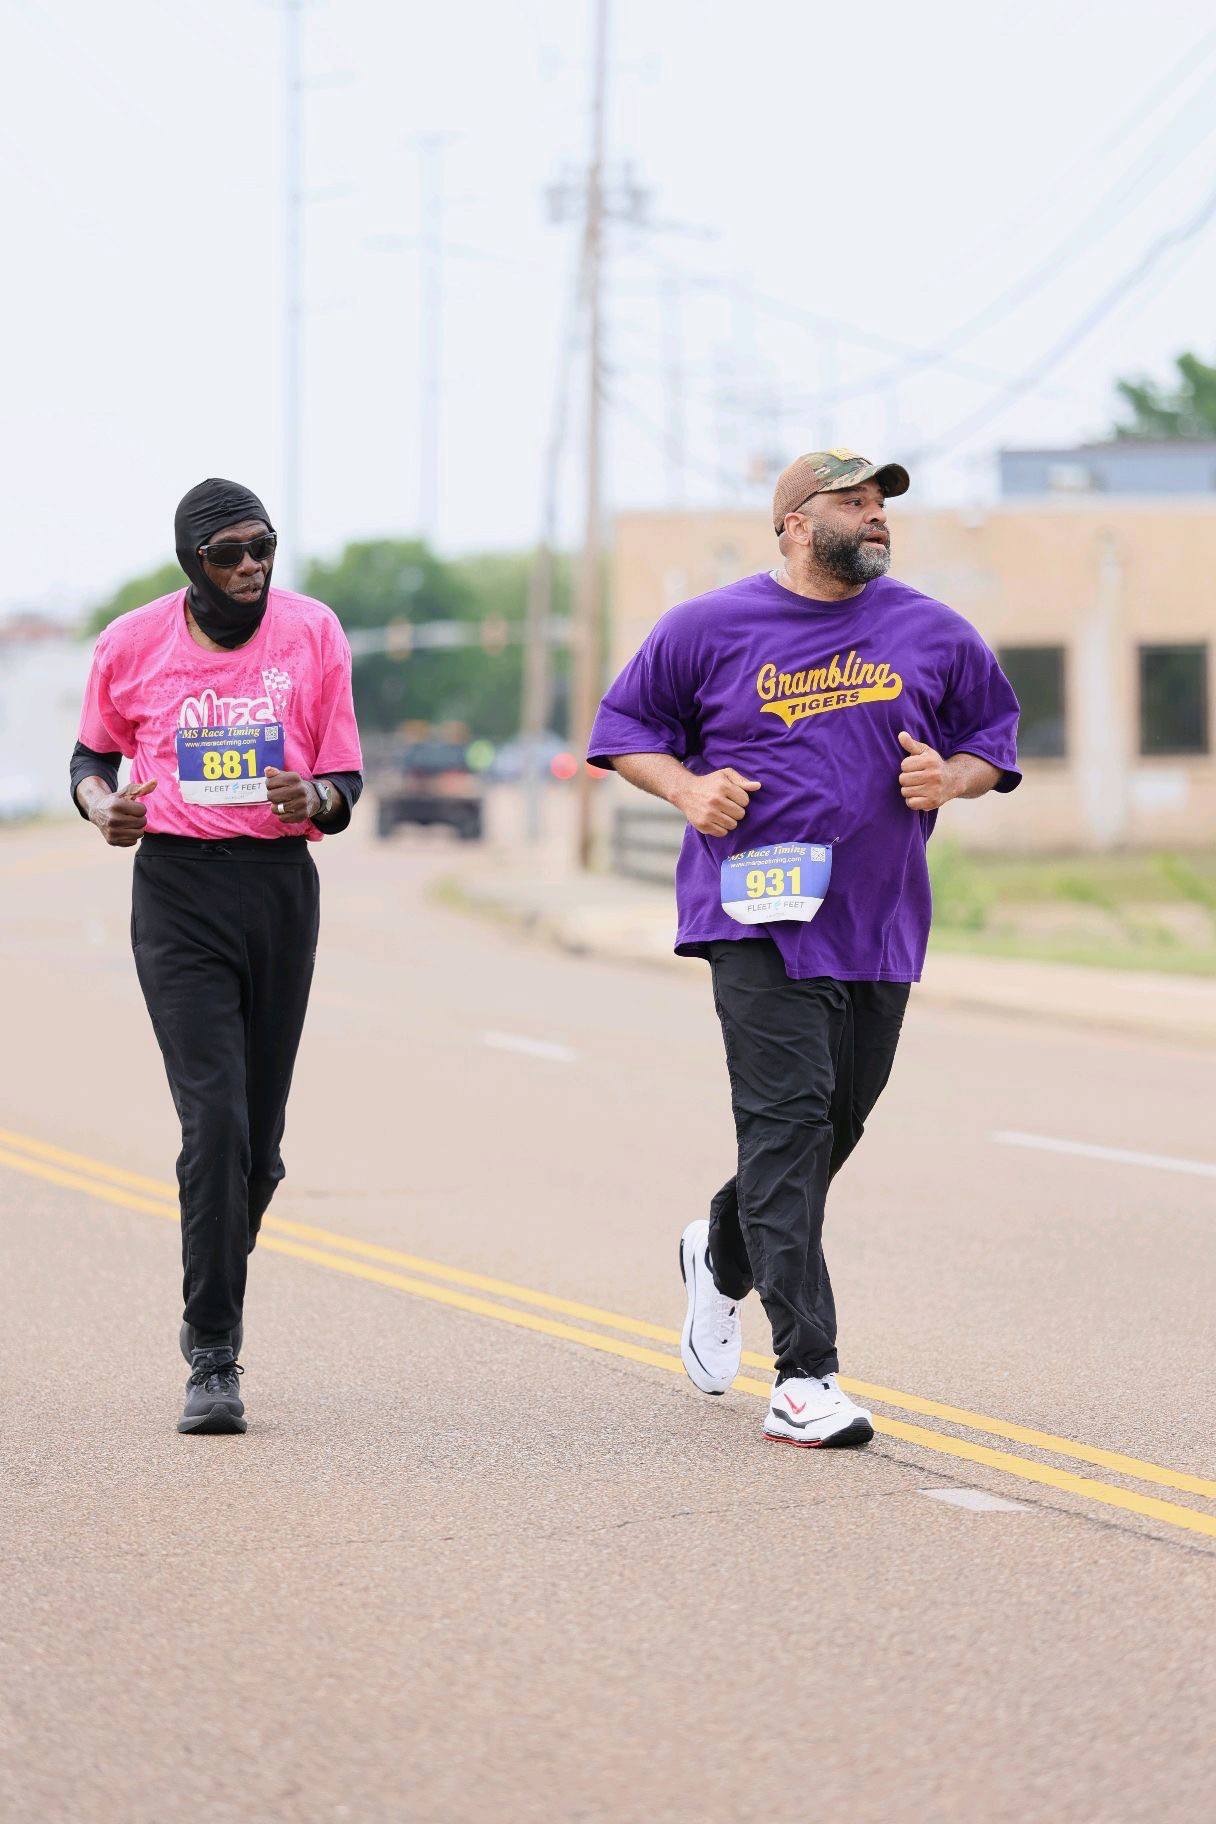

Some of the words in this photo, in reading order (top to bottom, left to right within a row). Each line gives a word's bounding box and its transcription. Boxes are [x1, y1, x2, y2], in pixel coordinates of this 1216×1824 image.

[757, 650, 894, 700] Grambling
[788, 691, 860, 715] TIGERS
[181, 728, 199, 739] MS
[201, 728, 225, 738] Race
[227, 727, 261, 737] Timing
[185, 739, 257, 747] www.msracetiming.com
[203, 749, 257, 780] 881
[204, 785, 230, 793] FLEET
[241, 783, 262, 791] FEET
[747, 849, 771, 858] Race
[773, 845, 807, 856] Timing
[746, 866, 801, 898] 931
[747, 903, 772, 912] FLEET
[783, 901, 805, 909] FEET
